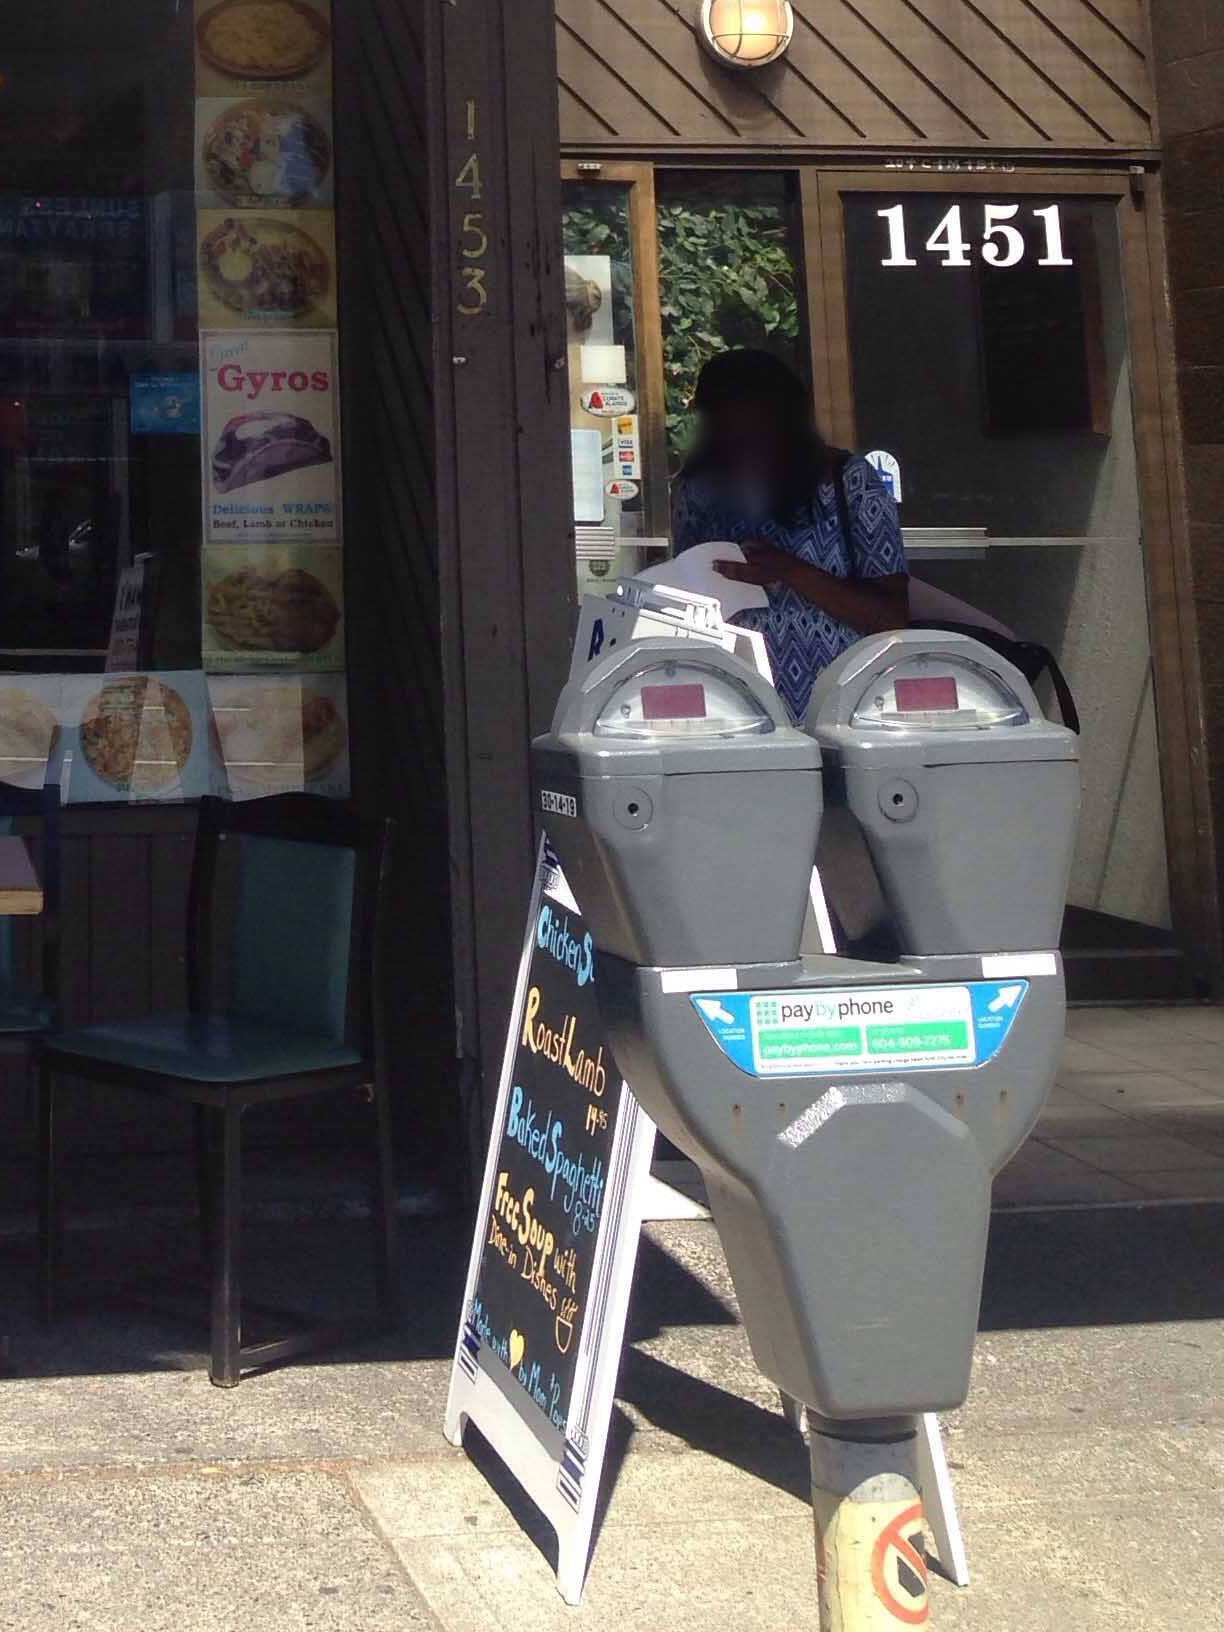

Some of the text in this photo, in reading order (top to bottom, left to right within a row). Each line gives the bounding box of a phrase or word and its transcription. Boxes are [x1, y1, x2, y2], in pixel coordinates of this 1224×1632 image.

[876, 203, 1074, 268] 1451
[216, 363, 329, 400] Gyros
[537, 905, 582, 974] Chicken
[521, 986, 606, 1097] Roast Lamb
[506, 1085, 604, 1218] Baked Spaghetti
[494, 1171, 577, 1295] Free Soup with
